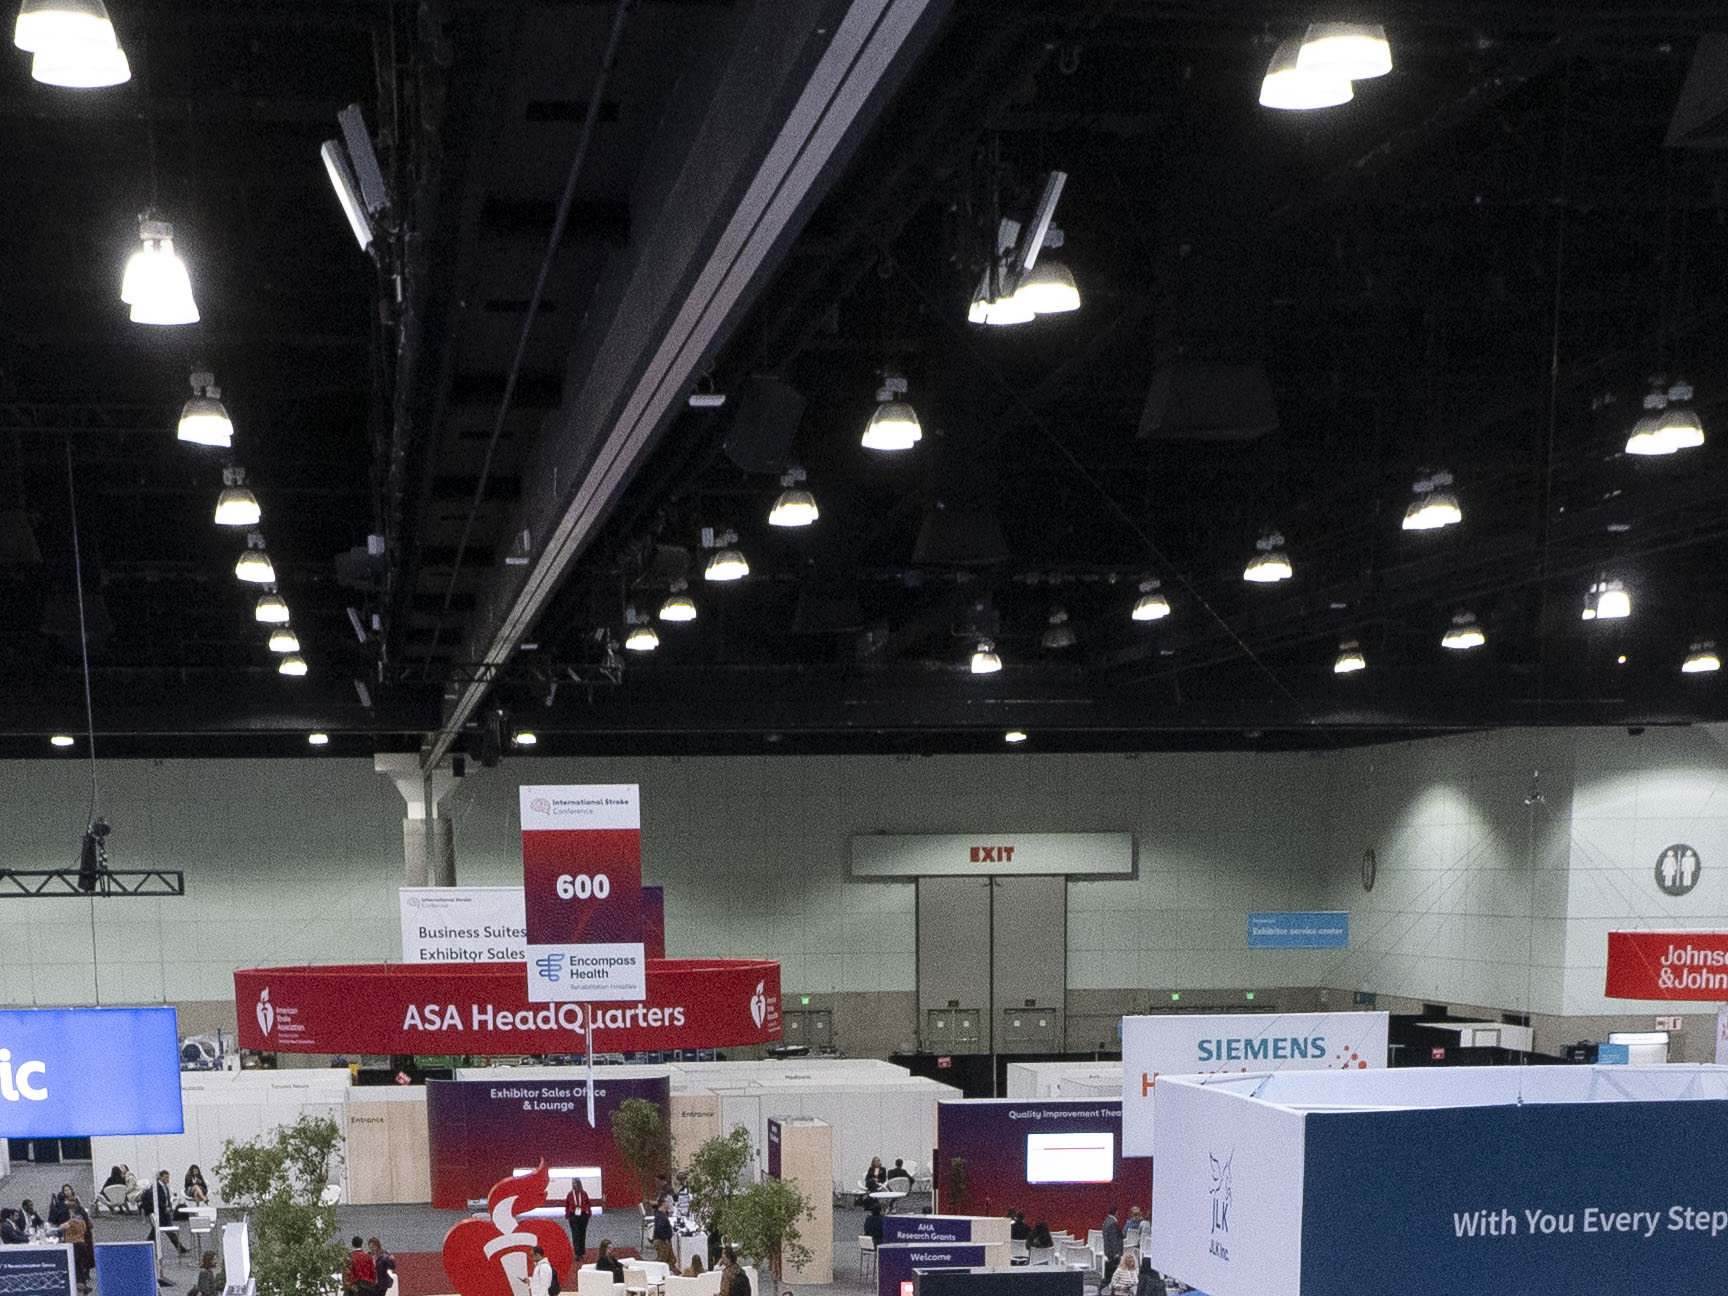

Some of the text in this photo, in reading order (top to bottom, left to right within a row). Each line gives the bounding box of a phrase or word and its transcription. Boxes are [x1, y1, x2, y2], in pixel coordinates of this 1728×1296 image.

[969, 846, 1015, 863] EXIT
[555, 874, 612, 900] 600
[418, 924, 527, 939] Business Suites
[419, 946, 525, 961] Exhibitor Sales
[569, 954, 637, 969] Encompass
[569, 968, 610, 980] Health
[403, 1002, 686, 1034] ASA HeadQuarters
[1197, 1036, 1327, 1062] SIEMENS
[490, 1085, 607, 1100] Exhibitor Sales Ofce
[522, 1100, 575, 1114] & Lounge
[681, 1110, 716, 1119] Entrance
[1008, 1109, 1042, 1121] Quality
[917, 1223, 935, 1232] AHA
[1453, 1209, 1517, 1238] With
[1523, 1208, 1574, 1236] You
[1582, 1206, 1660, 1240] Every
[1666, 1203, 1728, 1239] Step
[896, 1231, 957, 1242] Research Grants
[910, 1252, 952, 1262] Welcome
